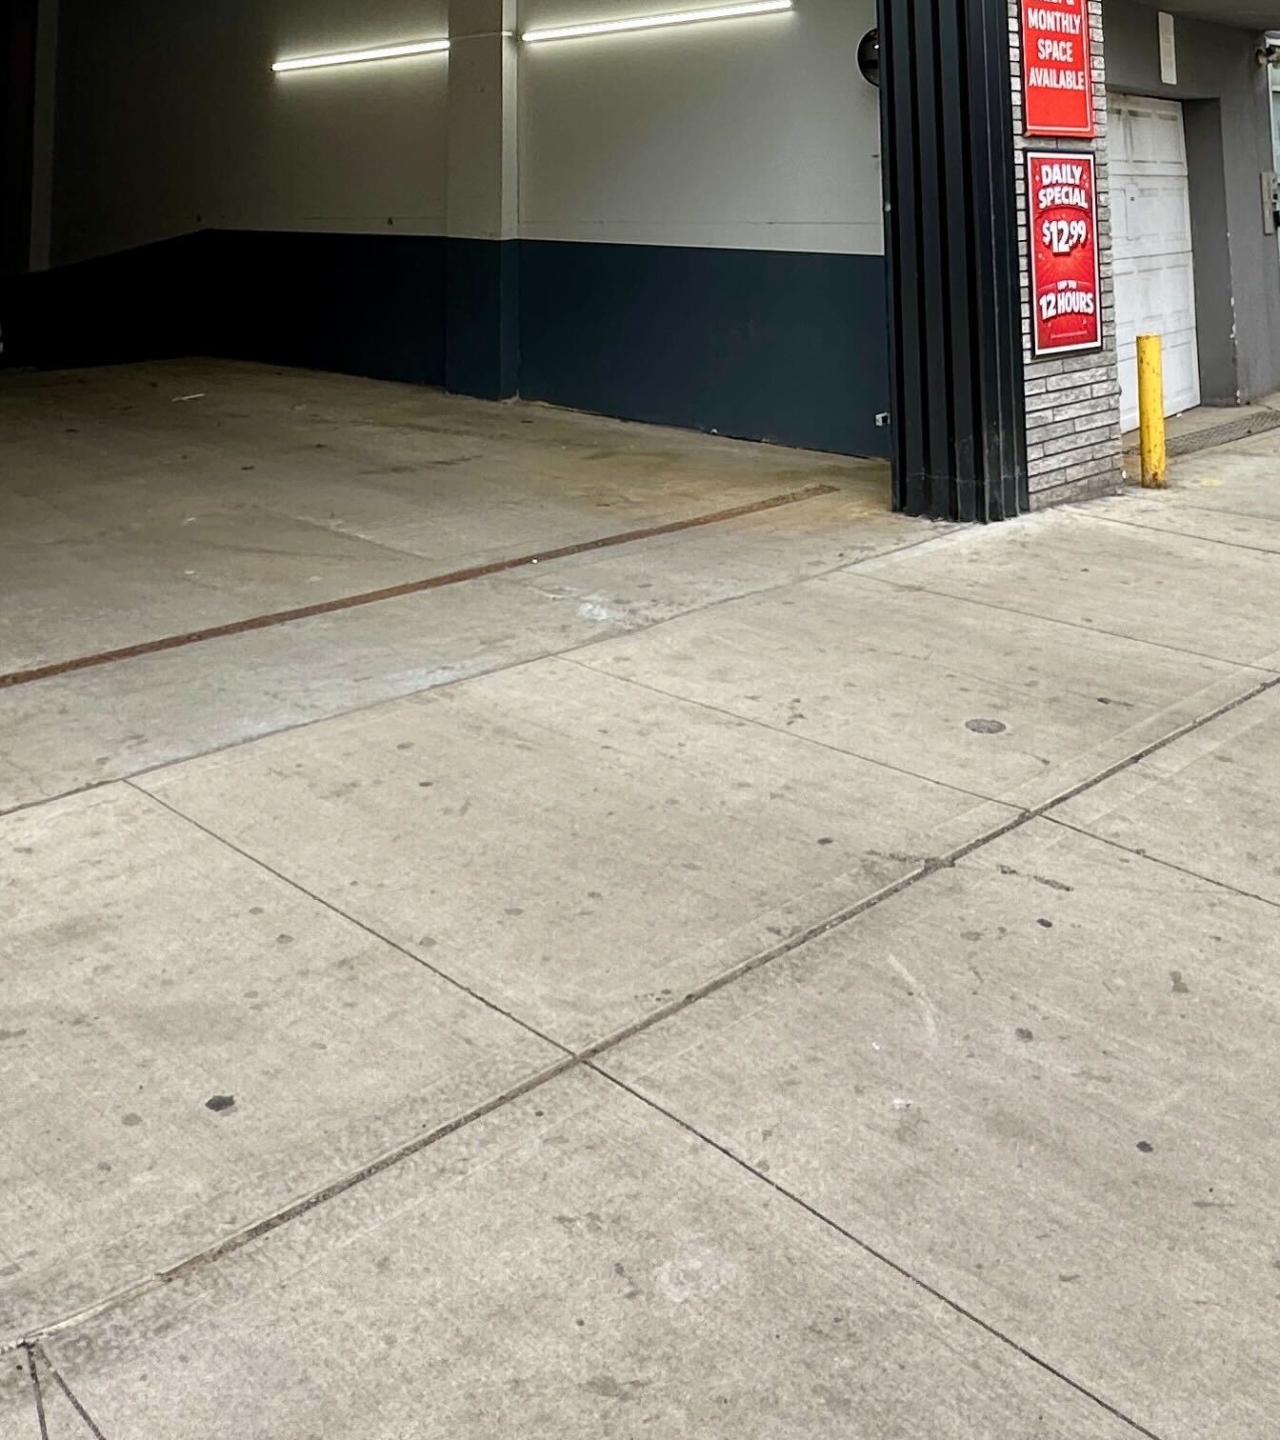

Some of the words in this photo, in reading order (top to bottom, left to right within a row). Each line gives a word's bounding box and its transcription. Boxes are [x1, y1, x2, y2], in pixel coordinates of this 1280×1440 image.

[1028, 7, 1081, 35] MONTHLY
[1037, 38, 1074, 63] SPACE
[1028, 67, 1085, 91] AVAILABLE
[1041, 164, 1082, 185] DAILY
[1038, 186, 1089, 209] SPECIAL
[1042, 219, 1087, 254] $12.99
[1039, 292, 1057, 321] 12
[1057, 290, 1094, 315] HOURS
